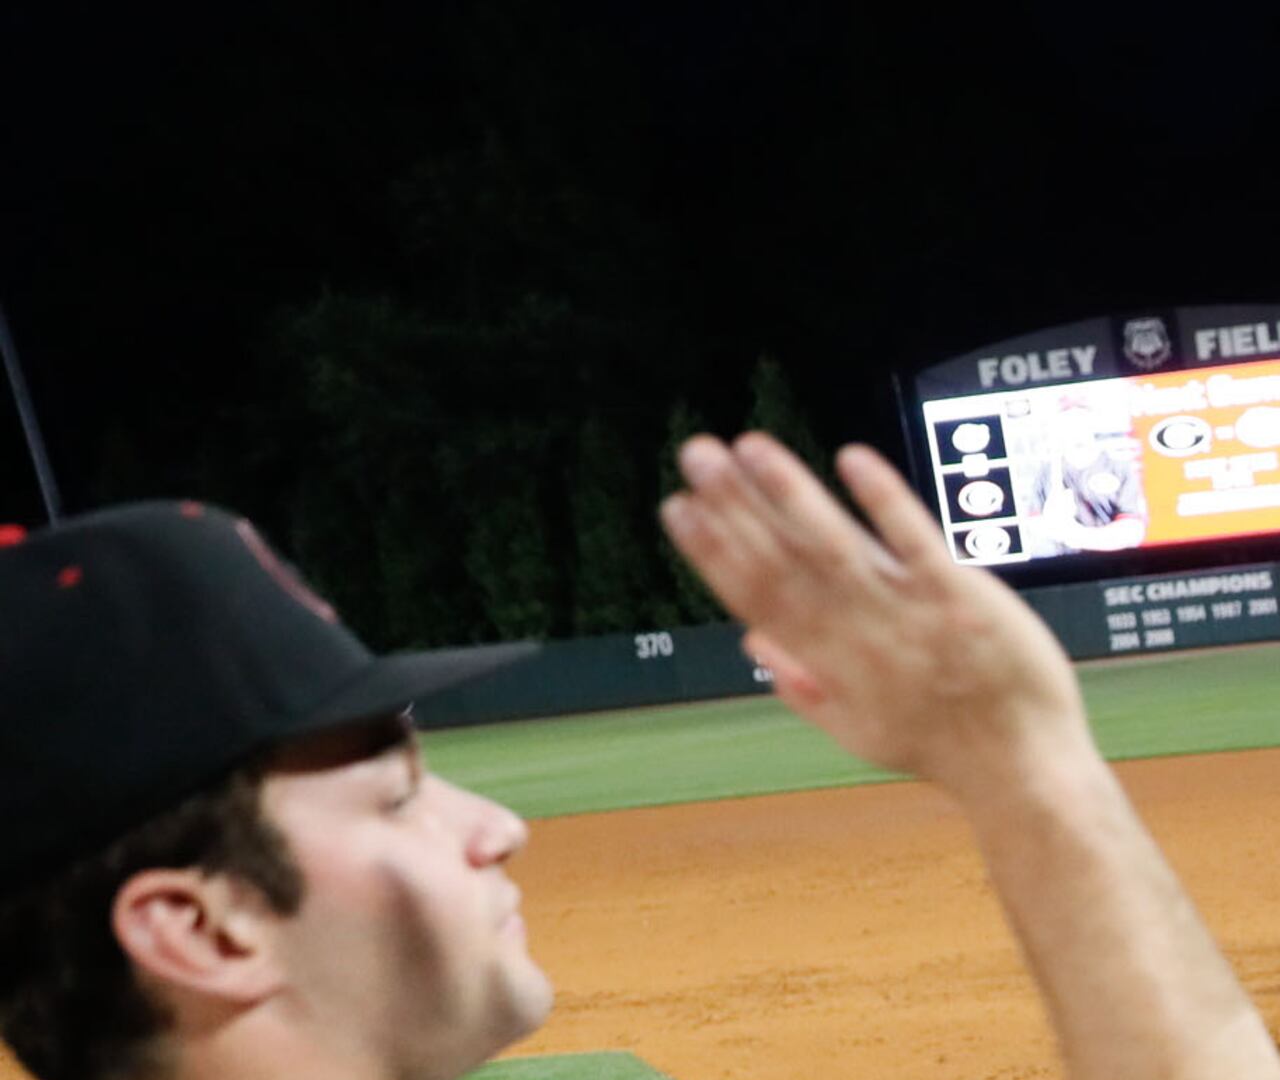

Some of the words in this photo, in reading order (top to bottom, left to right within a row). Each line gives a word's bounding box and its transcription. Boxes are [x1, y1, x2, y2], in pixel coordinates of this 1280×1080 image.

[977, 345, 1097, 387] FOLEY
[1104, 585, 1145, 606] SEC
[1146, 571, 1273, 599] CHAMPIONS
[634, 631, 674, 659] 370
